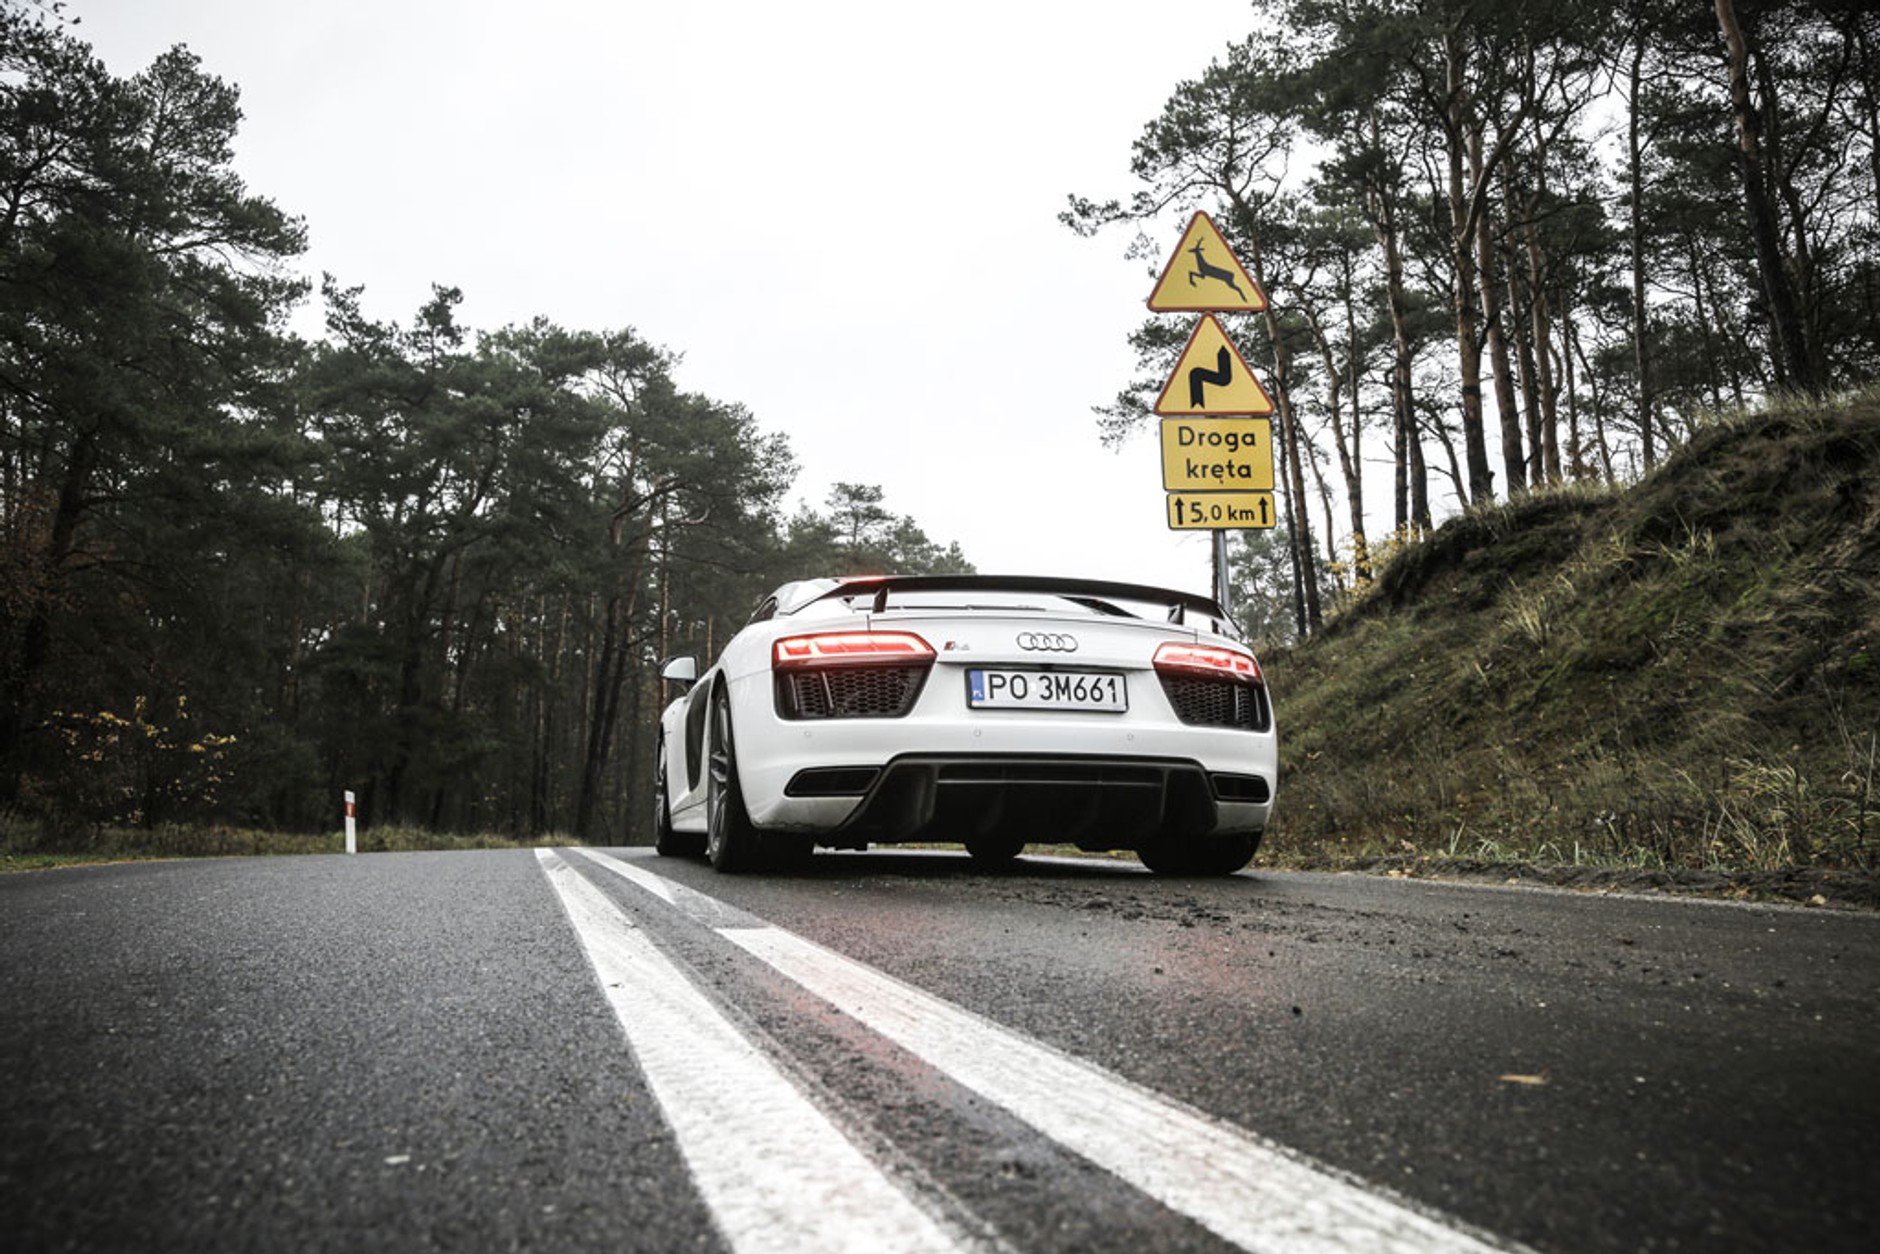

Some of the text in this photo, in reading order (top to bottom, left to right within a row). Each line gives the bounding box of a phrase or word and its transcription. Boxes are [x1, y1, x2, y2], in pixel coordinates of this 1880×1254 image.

[1178, 426, 1256, 453] Droga
[1186, 457, 1252, 484] kręta
[1190, 501, 1255, 523] 5,0 km
[988, 673, 1118, 703] PO 3M661
